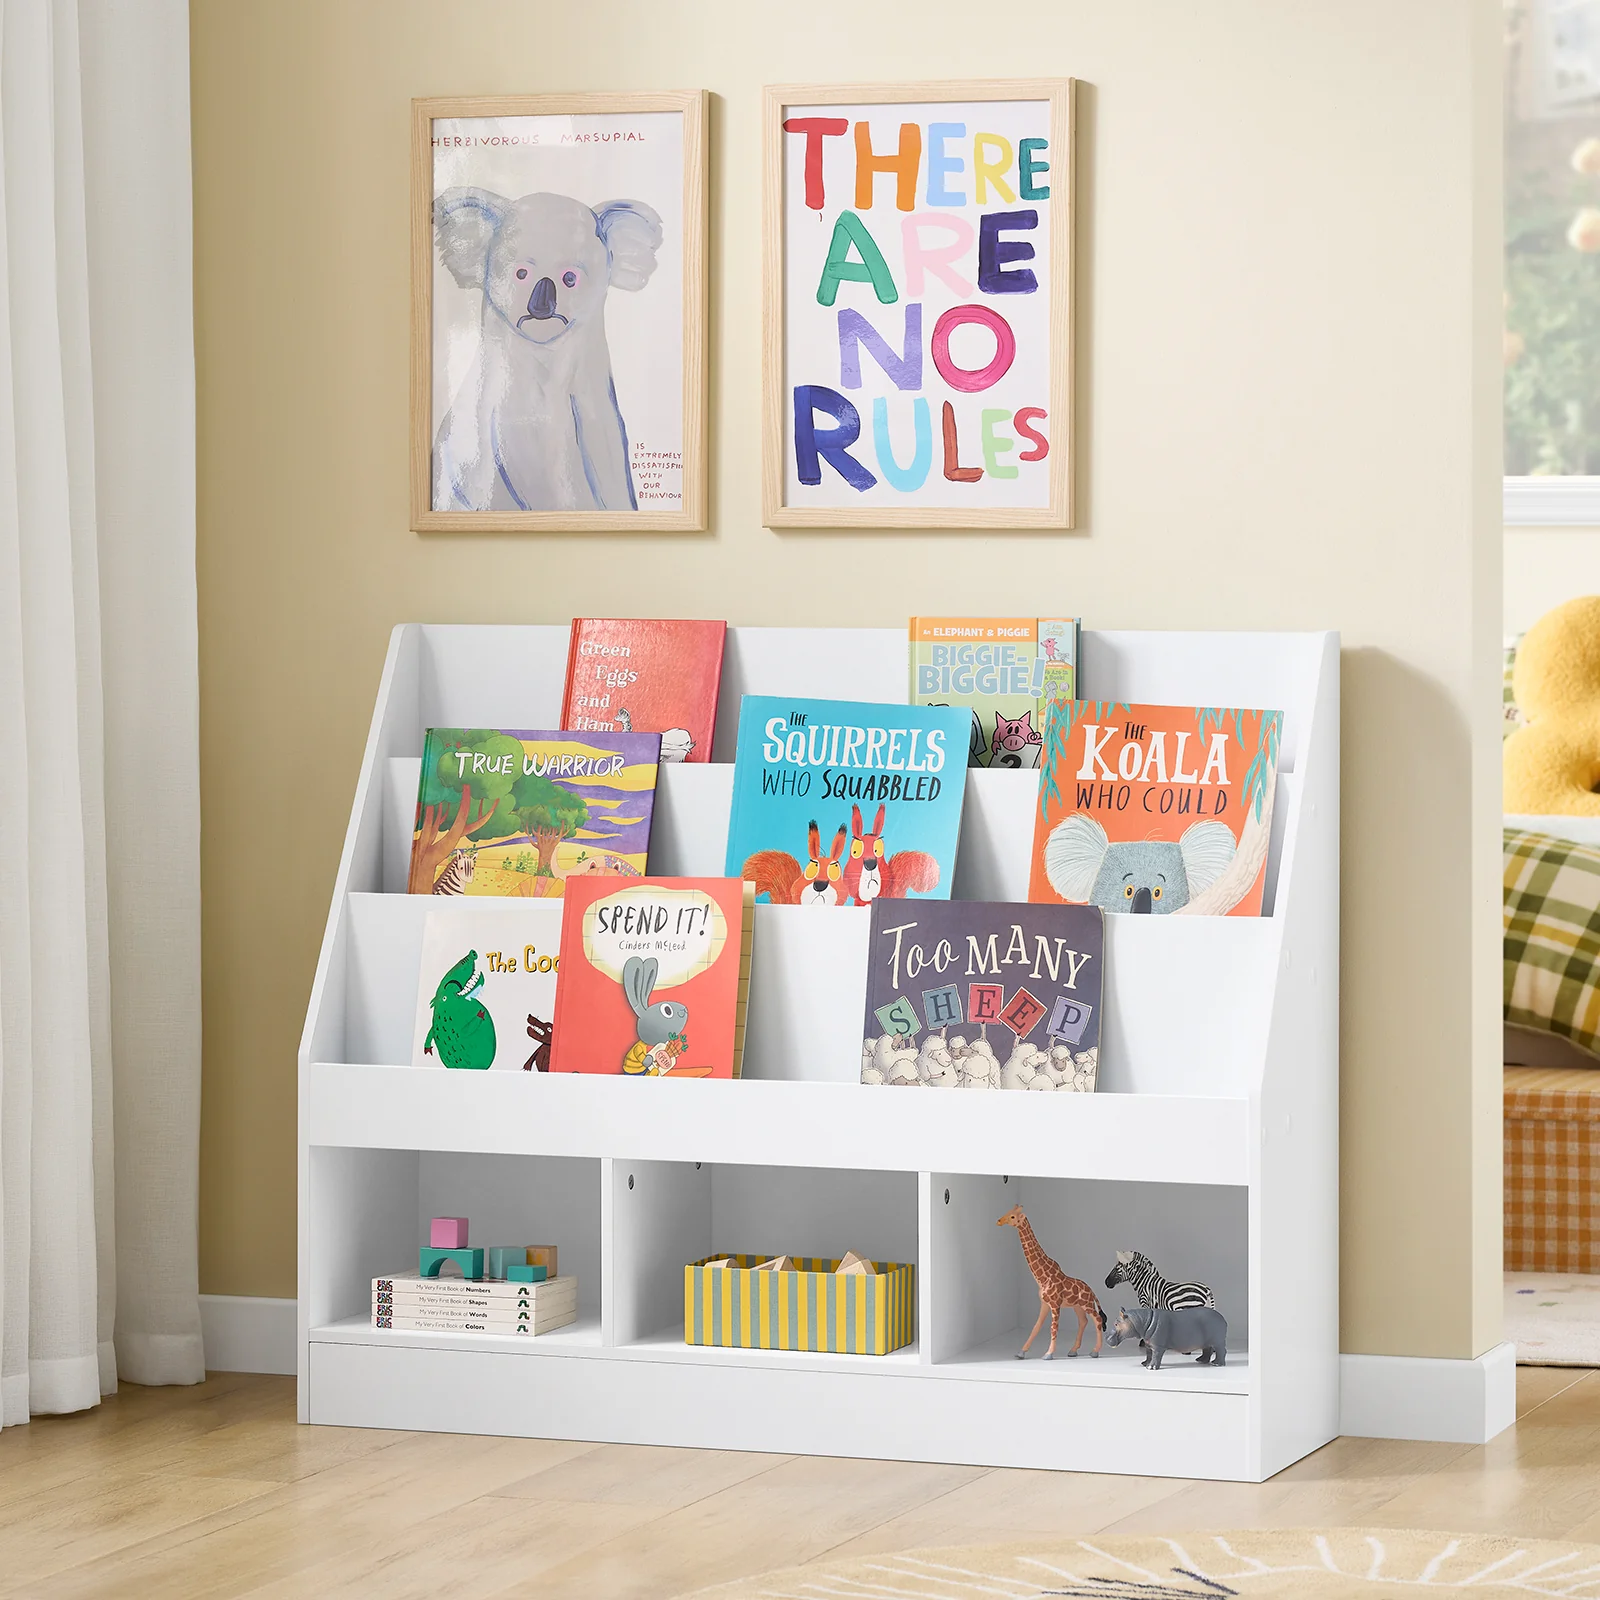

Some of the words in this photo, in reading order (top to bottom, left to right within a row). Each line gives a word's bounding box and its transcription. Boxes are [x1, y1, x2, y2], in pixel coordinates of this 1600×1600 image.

[431, 135, 540, 147] HERBIVOROUS
[560, 132, 646, 144] MARSUPIAL
[783, 117, 1050, 211] THERE
[816, 209, 1038, 307] ARE
[837, 303, 1016, 393] NO
[794, 384, 1049, 492] RULES
[933, 628, 984, 636] ELEPHANT
[986, 628, 994, 636] &
[997, 628, 1030, 637] PIGGIE
[580, 641, 631, 658] Green
[932, 644, 1028, 667] BIGGIE-
[595, 666, 638, 688] Eggs
[918, 656, 1046, 698] BIGGIE!
[577, 694, 611, 708] and
[576, 716, 614, 732] Ham
[790, 711, 808, 726] THE
[1124, 721, 1148, 740] THE
[762, 717, 946, 773] SQUIRRELS
[1076, 724, 1232, 785] KOALA
[454, 752, 514, 779] TRUE
[522, 752, 625, 778] WARRIOR
[762, 768, 811, 797] WHO
[821, 768, 942, 802] SQUABBLED
[1076, 782, 1131, 810] WHO
[1142, 786, 1228, 815] COULD
[598, 904, 668, 936] SPEND
[676, 904, 710, 936] IT!
[618, 940, 651, 950] Cinders
[654, 940, 686, 952] McLeod
[882, 922, 960, 990] Too
[964, 924, 1092, 990] MANY
[486, 951, 517, 974] The
[889, 988, 1082, 1036] SHEEP
